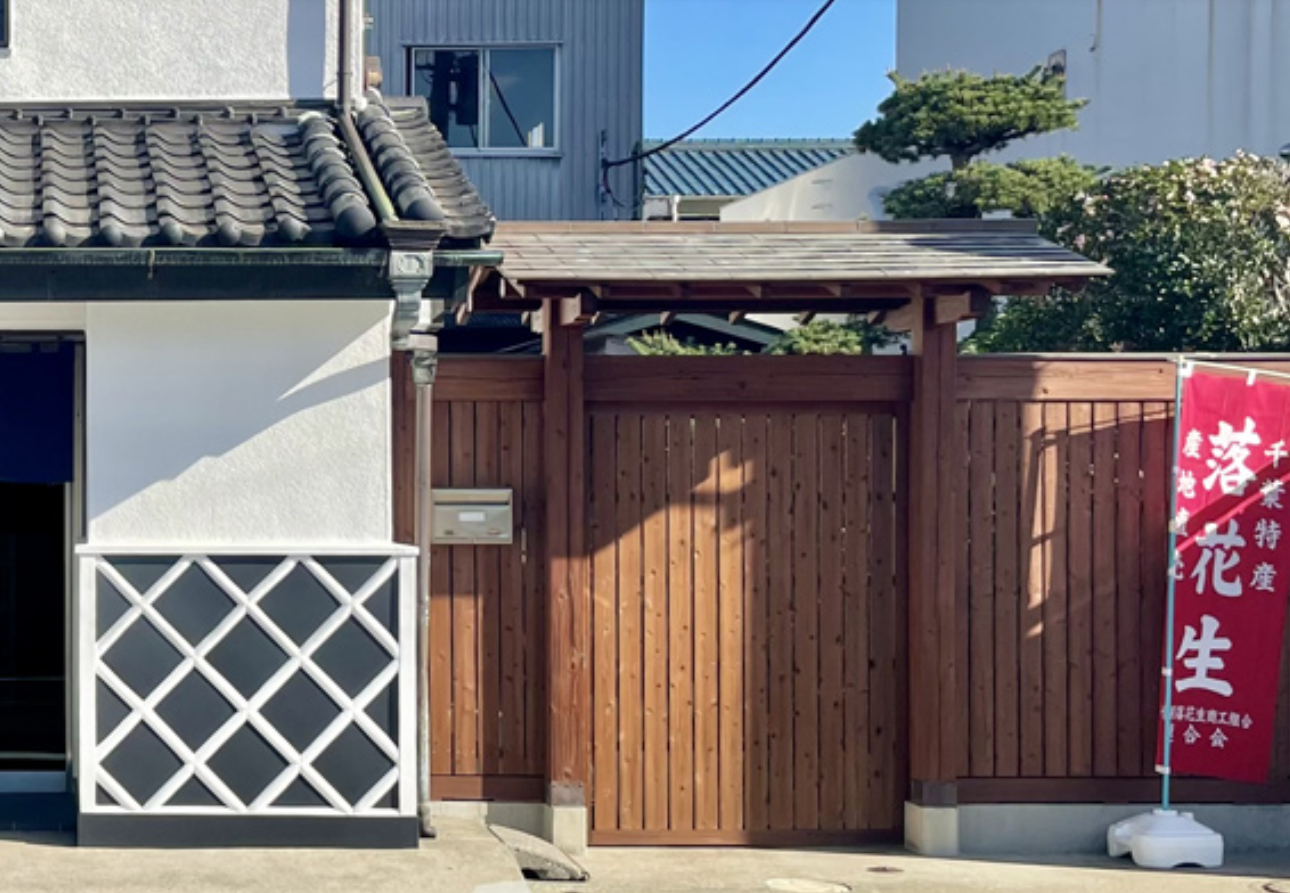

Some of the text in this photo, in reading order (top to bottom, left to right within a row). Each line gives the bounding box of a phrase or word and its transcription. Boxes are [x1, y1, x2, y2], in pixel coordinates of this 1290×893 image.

[1175, 416, 1262, 697] 落花生
[1250, 438, 1289, 592] 千葉特産
[1169, 722, 1229, 749] 合会
